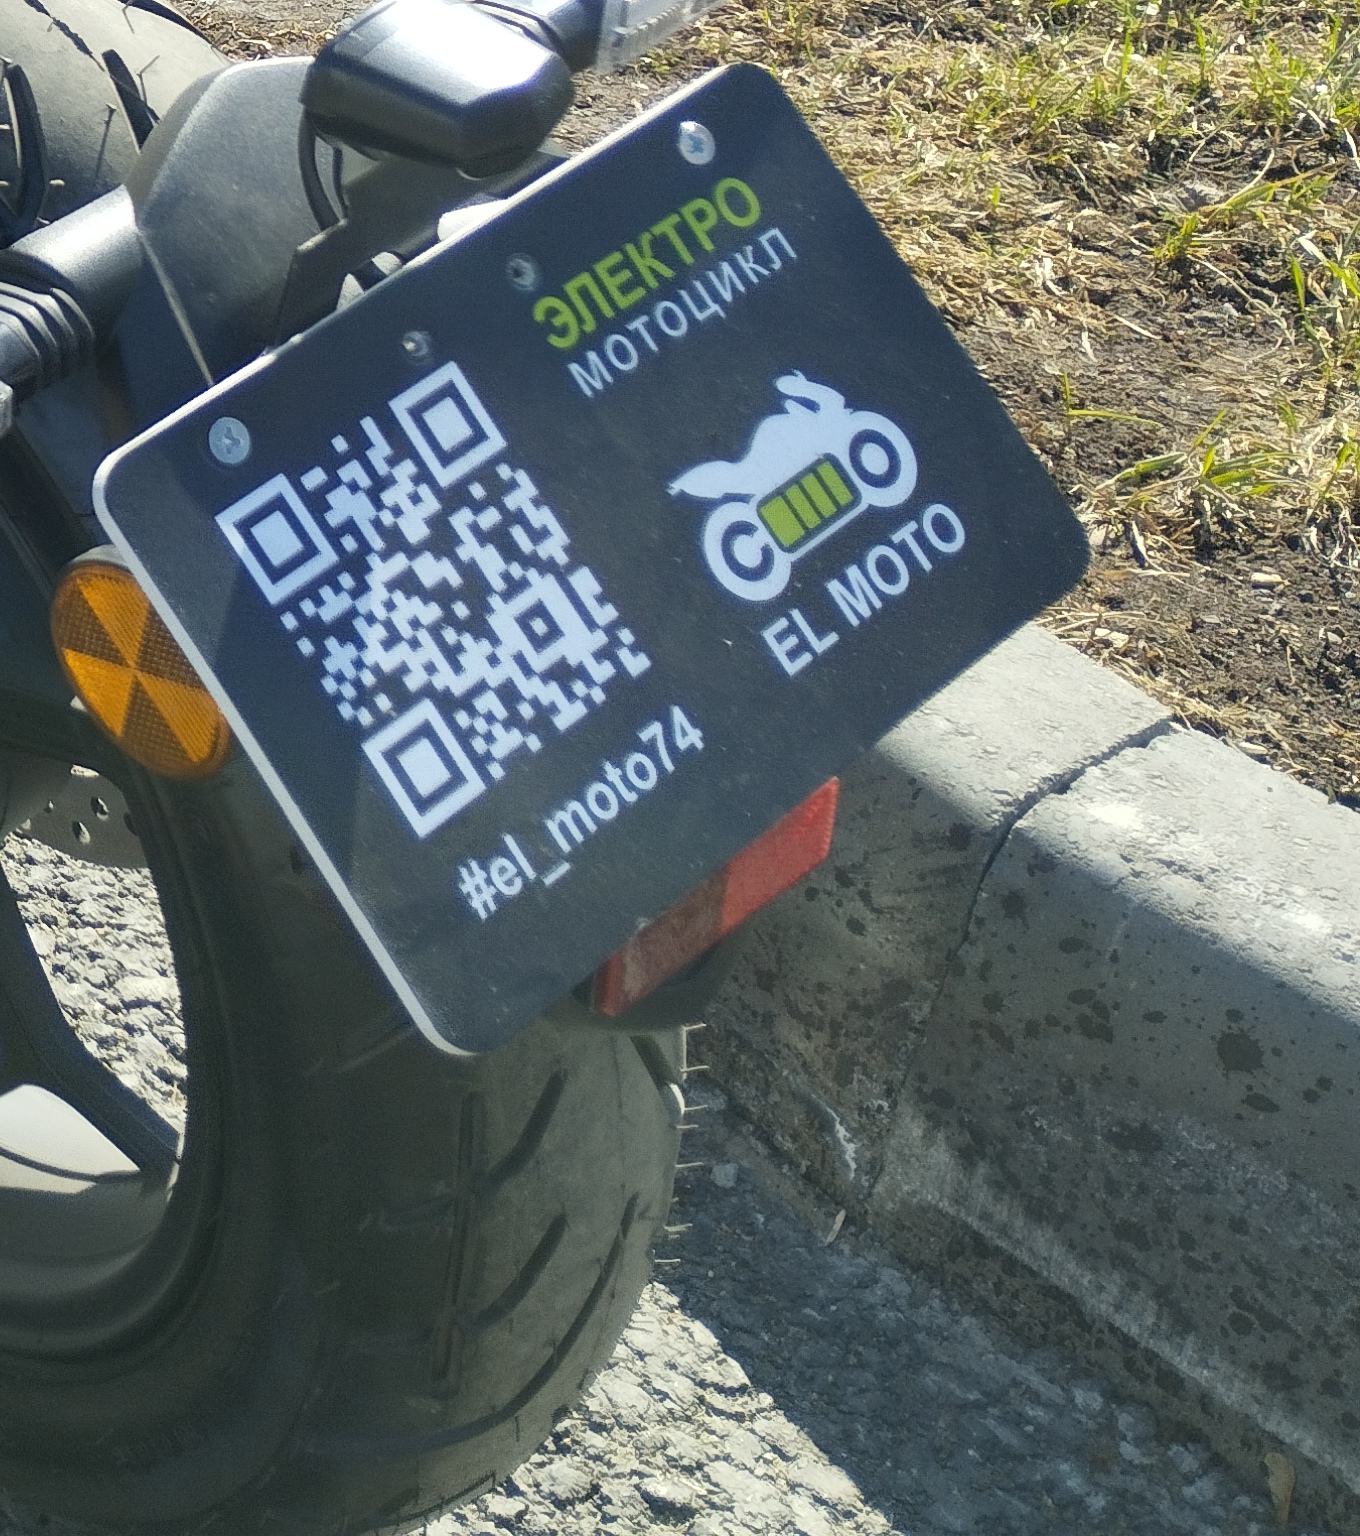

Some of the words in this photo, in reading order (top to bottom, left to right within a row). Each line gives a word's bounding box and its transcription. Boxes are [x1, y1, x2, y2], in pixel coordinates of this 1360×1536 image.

[534, 177, 760, 349] ЭЛЕКТРО
[568, 228, 796, 398] МОТОЦИКЛ
[760, 608, 840, 676] EL
[825, 503, 965, 627] MOTO
[458, 705, 705, 921] #el_moto74
